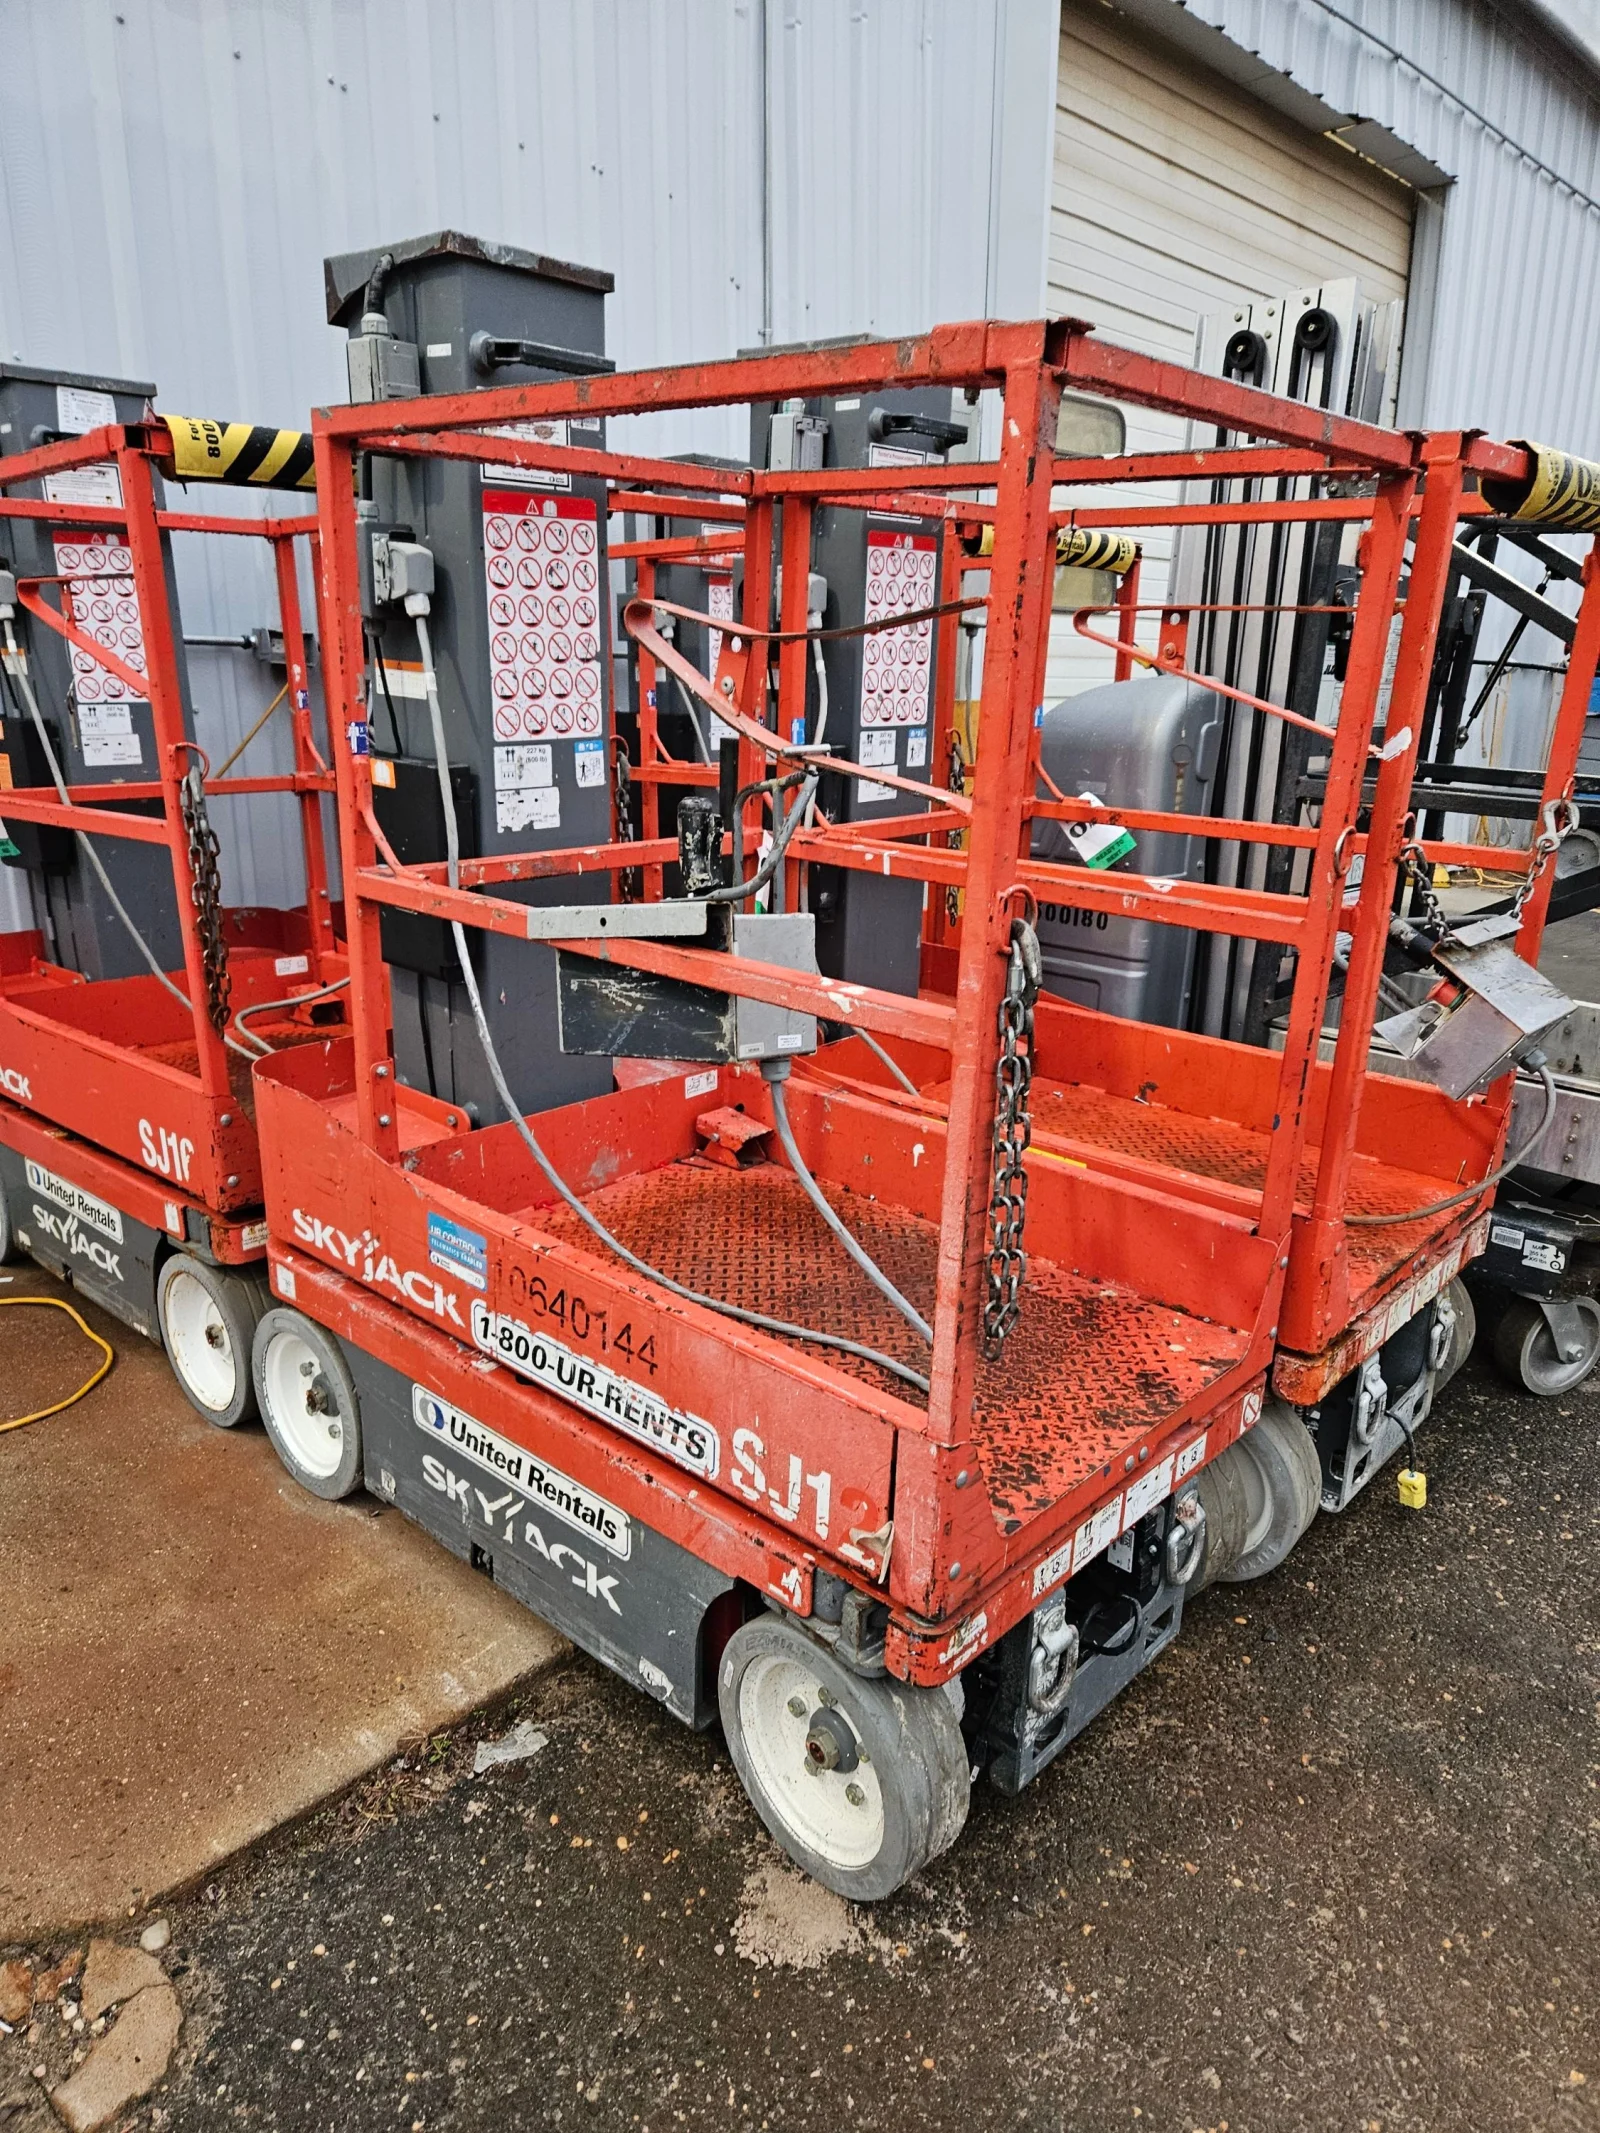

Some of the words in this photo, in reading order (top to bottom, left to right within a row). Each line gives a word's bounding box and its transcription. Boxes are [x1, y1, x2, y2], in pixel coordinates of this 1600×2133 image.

[188, 422, 201, 441] For
[538, 747, 546, 755] kg
[1095, 842, 1117, 862] READY
[1106, 850, 1122, 863] RENT
[42, 1174, 75, 1207] United
[78, 1194, 117, 1232] Rentals
[32, 1204, 124, 1281] SKYJACK
[292, 1208, 466, 1328] SKYJACK
[479, 1316, 707, 1460] 1-800-UR-RENTS
[450, 1415, 523, 1480] United
[527, 1464, 620, 1540] Rentals
[421, 1454, 623, 1616] SKYJACK
